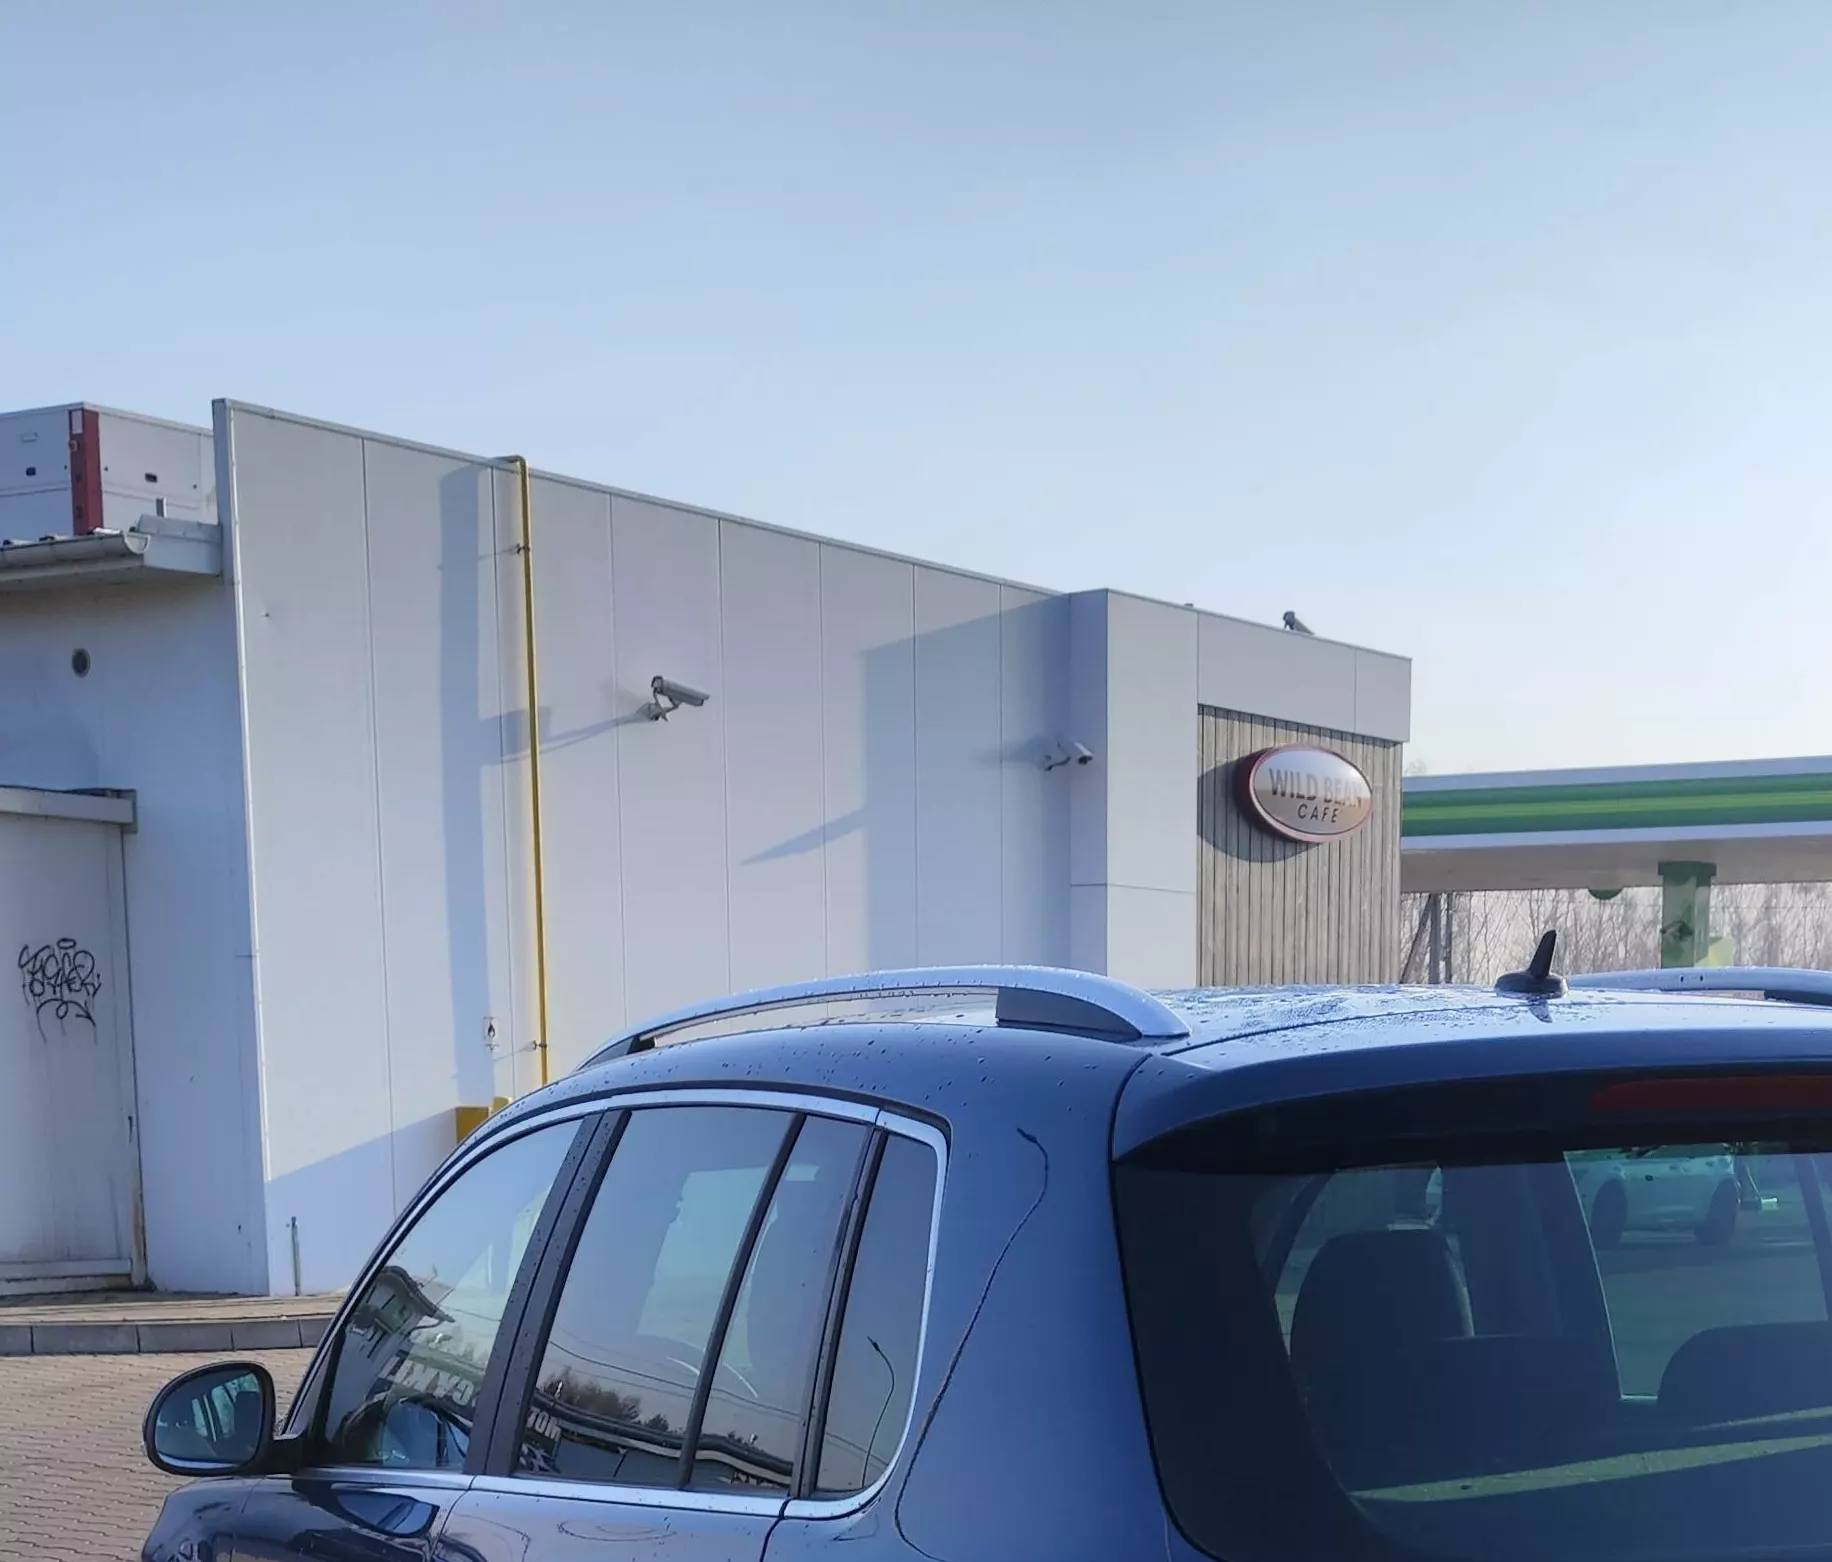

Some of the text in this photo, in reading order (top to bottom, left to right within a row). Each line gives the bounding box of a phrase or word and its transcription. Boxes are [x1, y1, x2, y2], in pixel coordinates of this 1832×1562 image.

[1268, 767, 1363, 809] WILD BEAN
[1297, 803, 1339, 823] CAFE
